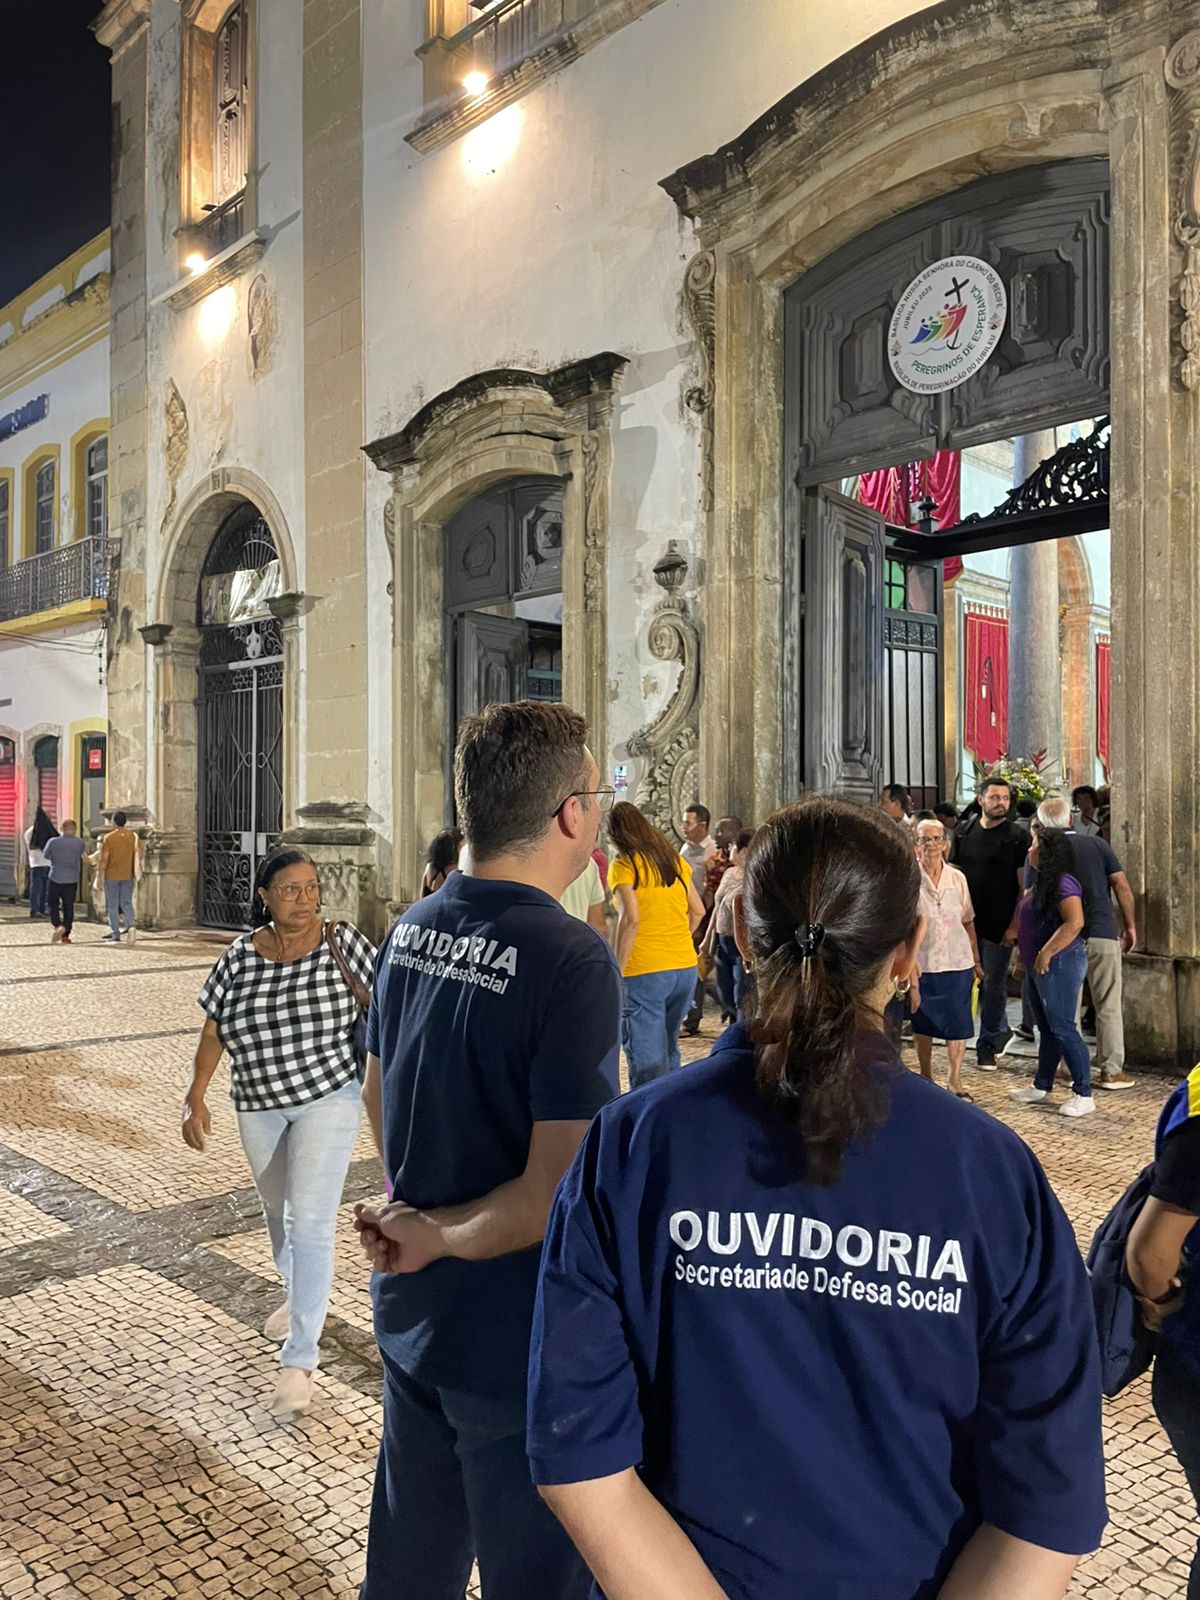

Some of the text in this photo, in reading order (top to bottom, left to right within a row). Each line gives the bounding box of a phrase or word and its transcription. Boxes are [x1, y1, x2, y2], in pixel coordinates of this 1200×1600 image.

[904, 279, 922, 303] NOSSA
[922, 260, 955, 281] SENHORA
[955, 259, 966, 267] DO
[966, 260, 989, 276] CARMO
[986, 273, 995, 284] DO
[993, 282, 1004, 309] RECIFE
[904, 285, 933, 330] JUBILEU 2025
[911, 285, 988, 375] PEREGRINOS DE ESPERANÇA
[910, 380, 920, 389] DE
[918, 371, 967, 391] PEREGRINAÇÃO
[966, 362, 977, 375] DO
[976, 335, 997, 365] JUBILEU
[391, 922, 518, 977] OUVIDORIA
[668, 1209, 969, 1283] OUVIDORIA
[812, 1266, 893, 1307] Defesa
[896, 1280, 962, 1315] Social
